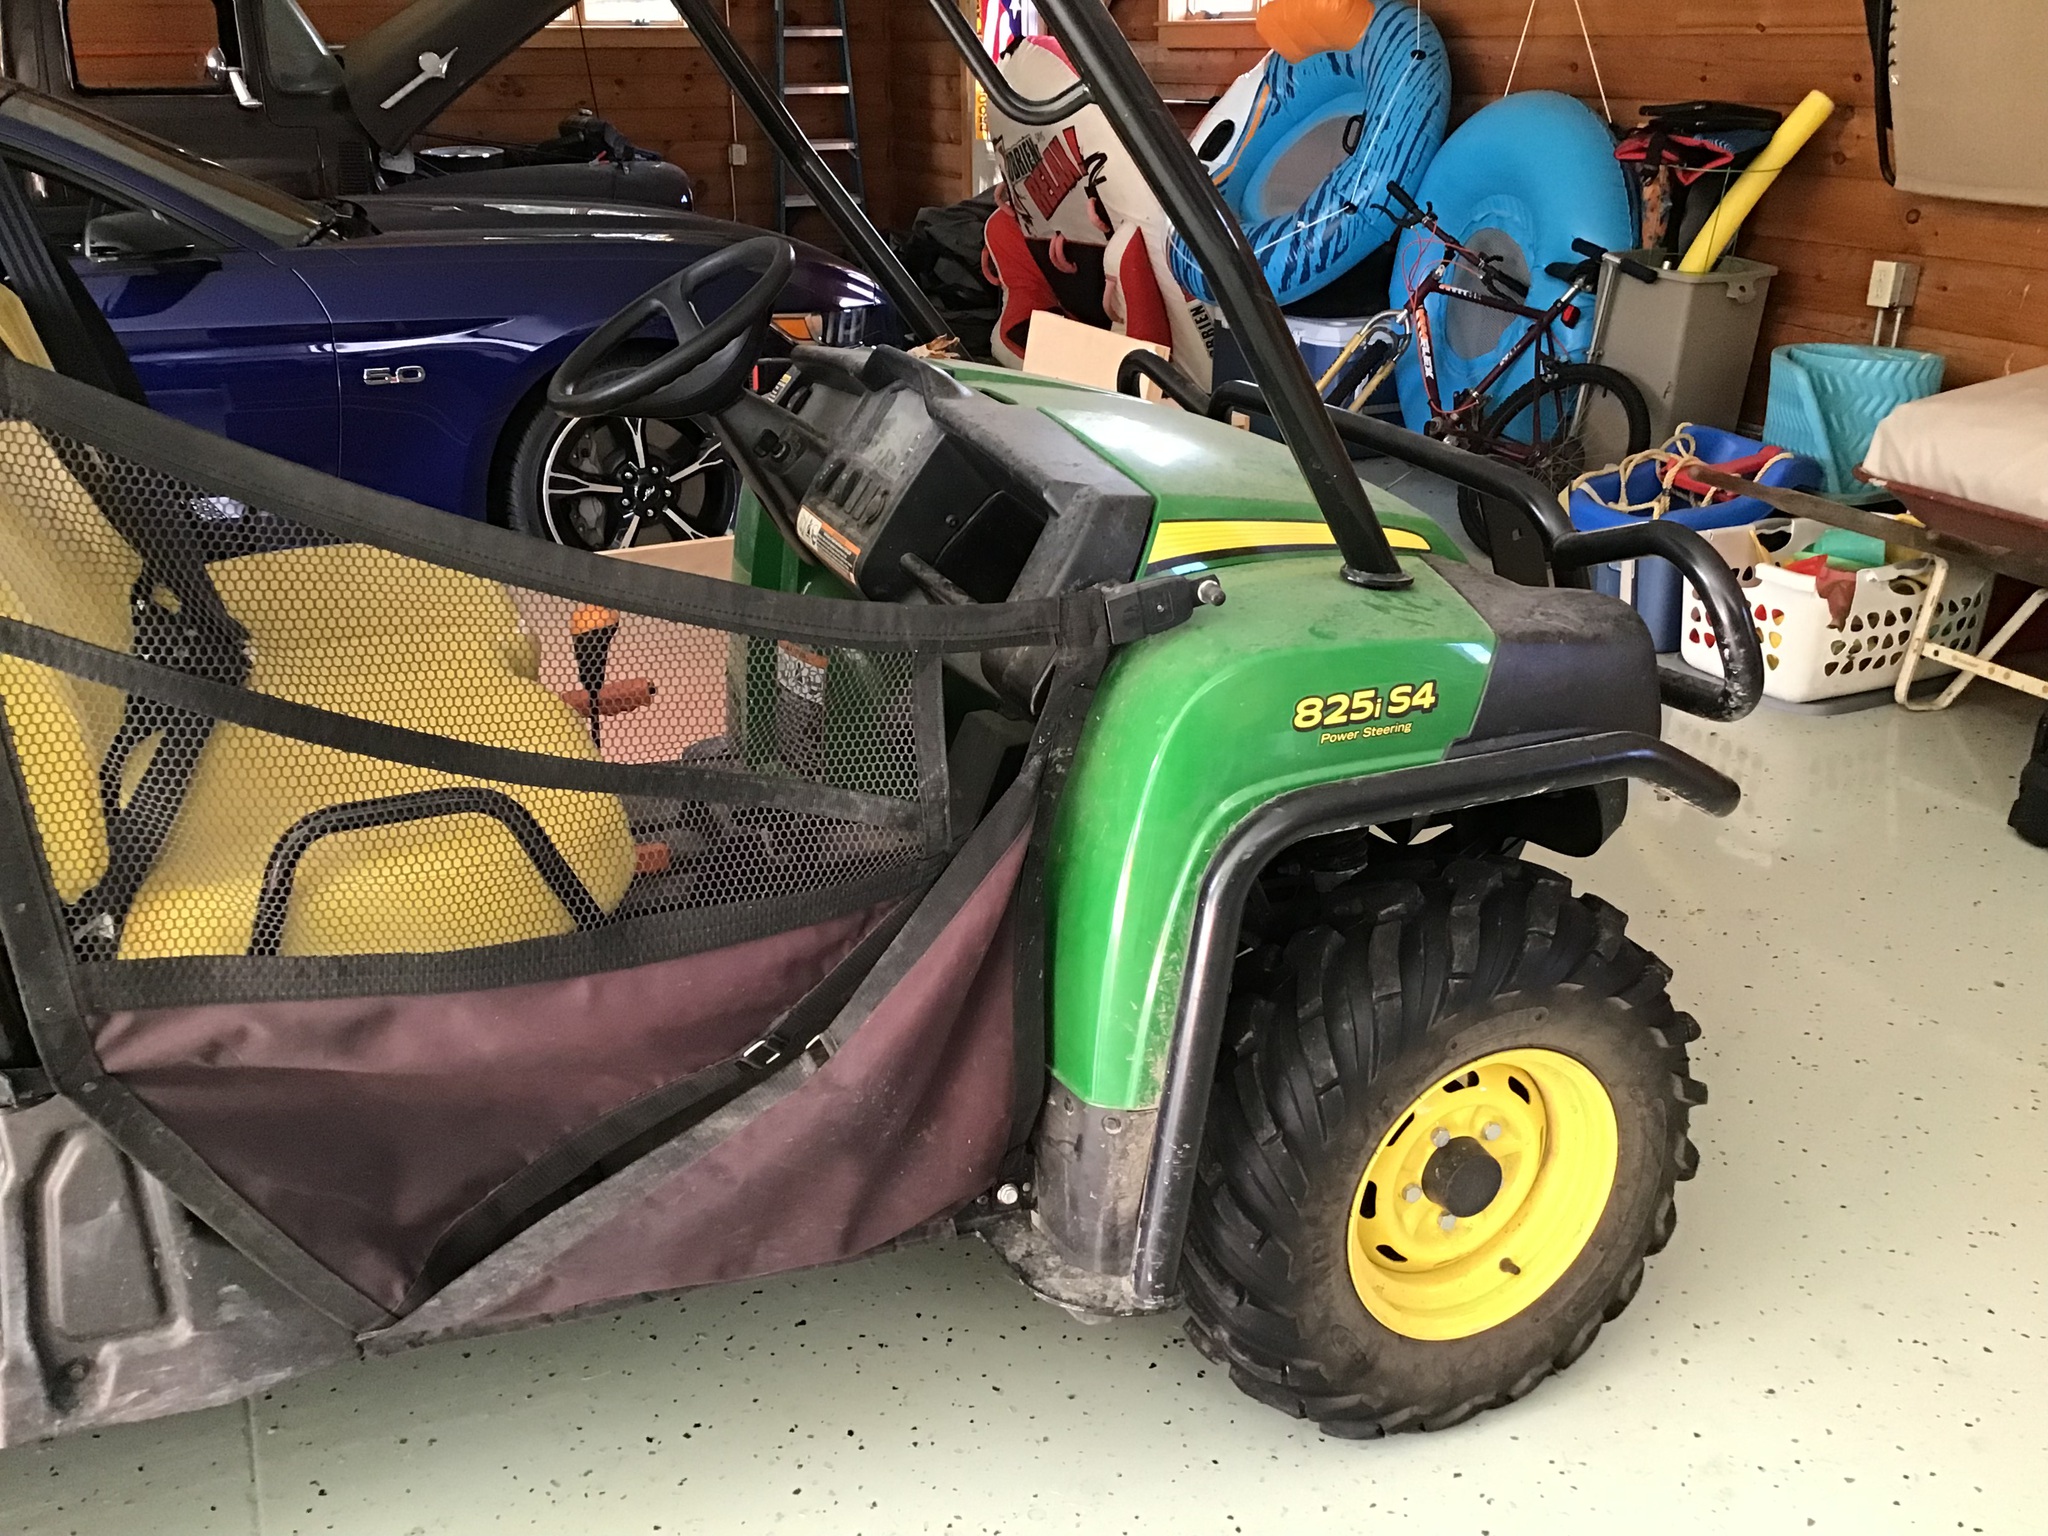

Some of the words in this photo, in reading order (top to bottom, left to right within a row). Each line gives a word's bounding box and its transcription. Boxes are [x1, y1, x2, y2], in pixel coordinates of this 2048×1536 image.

[1023, 125, 1089, 221] RELAX!
[363, 365, 426, 386] 5.0
[1293, 687, 1383, 732] 825i
[1386, 679, 1439, 718] S4
[1320, 730, 1359, 744] Power
[1362, 722, 1412, 738] Steering
